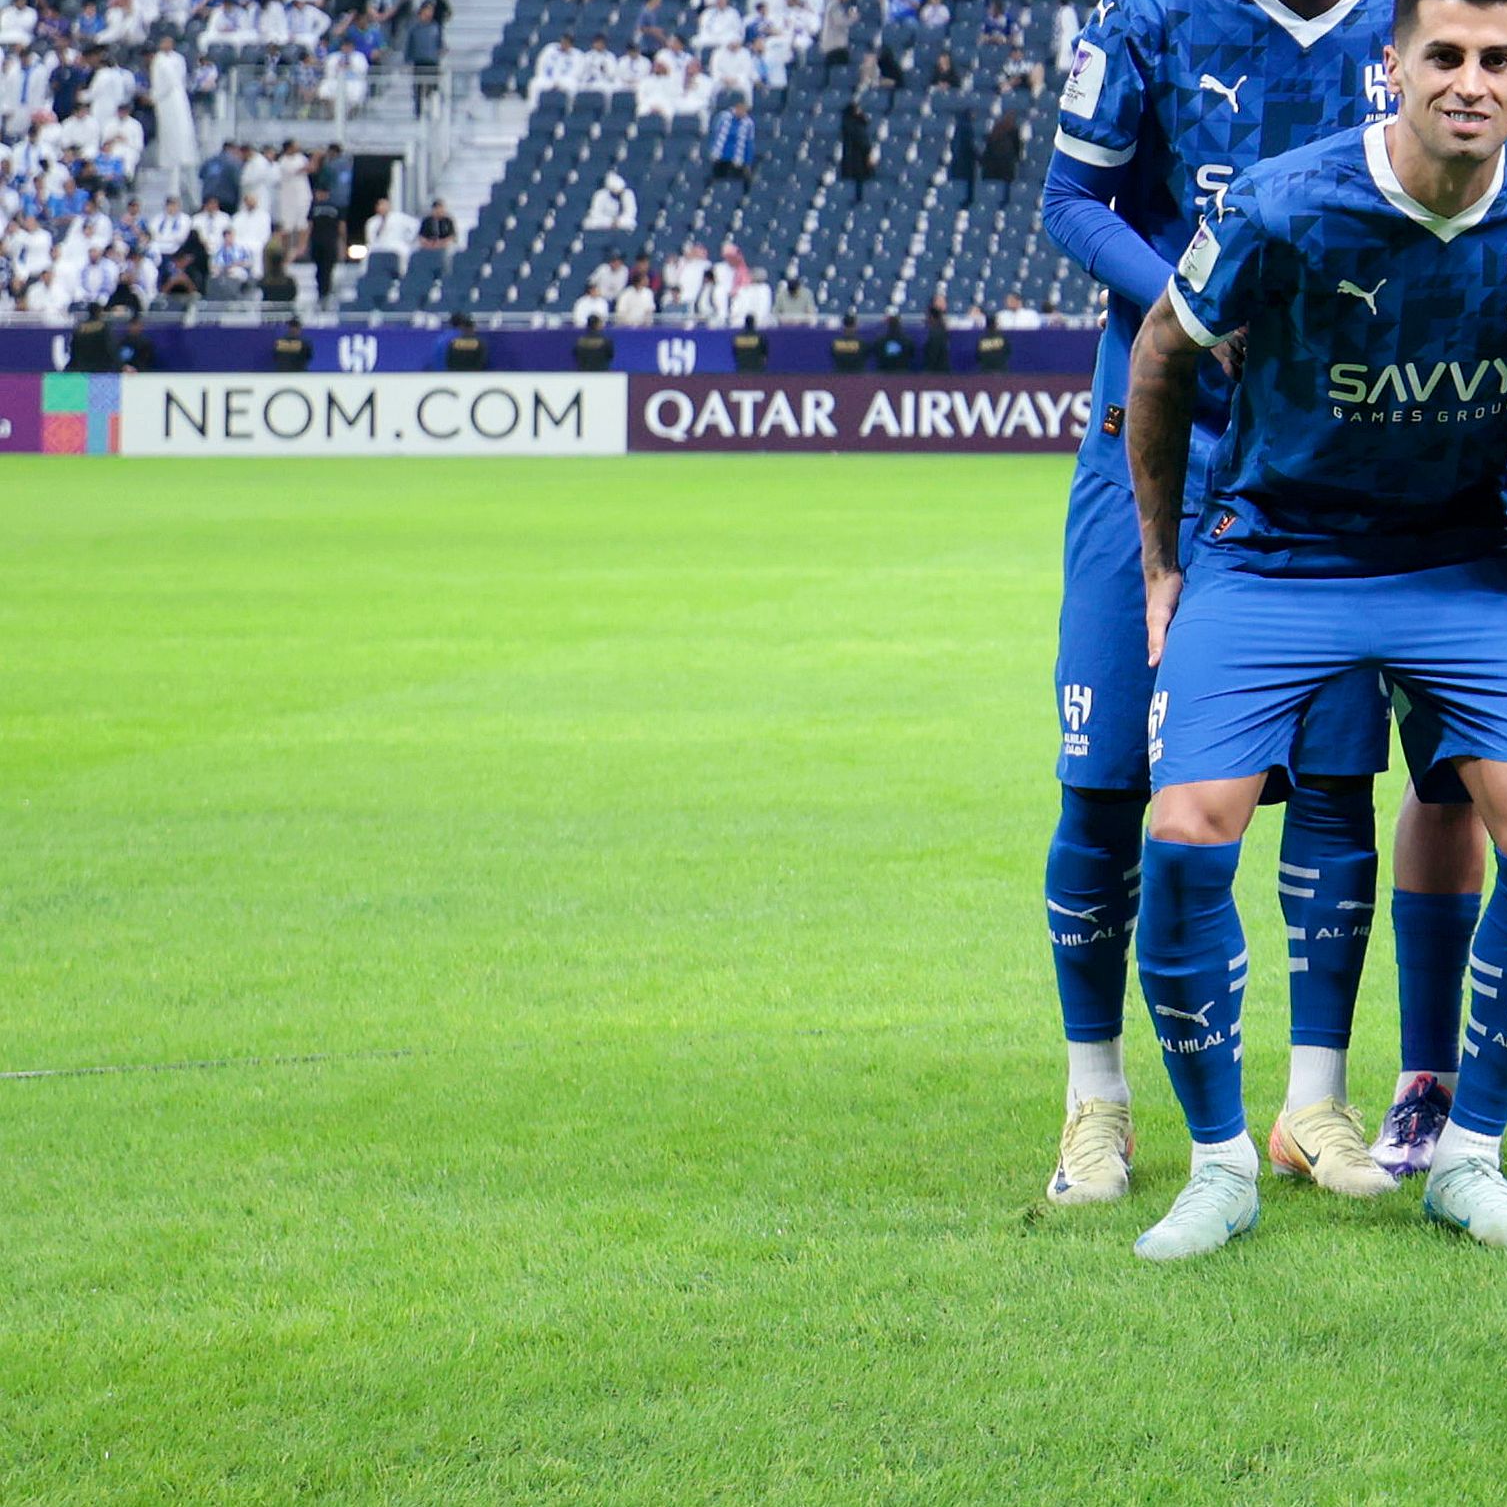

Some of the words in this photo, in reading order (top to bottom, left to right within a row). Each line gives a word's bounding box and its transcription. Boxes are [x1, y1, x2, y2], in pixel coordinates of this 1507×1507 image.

[163, 387, 583, 439] NEOM.COM
[644, 389, 838, 442] QATAR
[858, 389, 1093, 438] AIRWAYS
[1333, 406, 1422, 422] GAMES
[1061, 927, 1116, 946] HILAL
[1315, 927, 1344, 940] AL
[1178, 1030, 1225, 1054] HILAL
